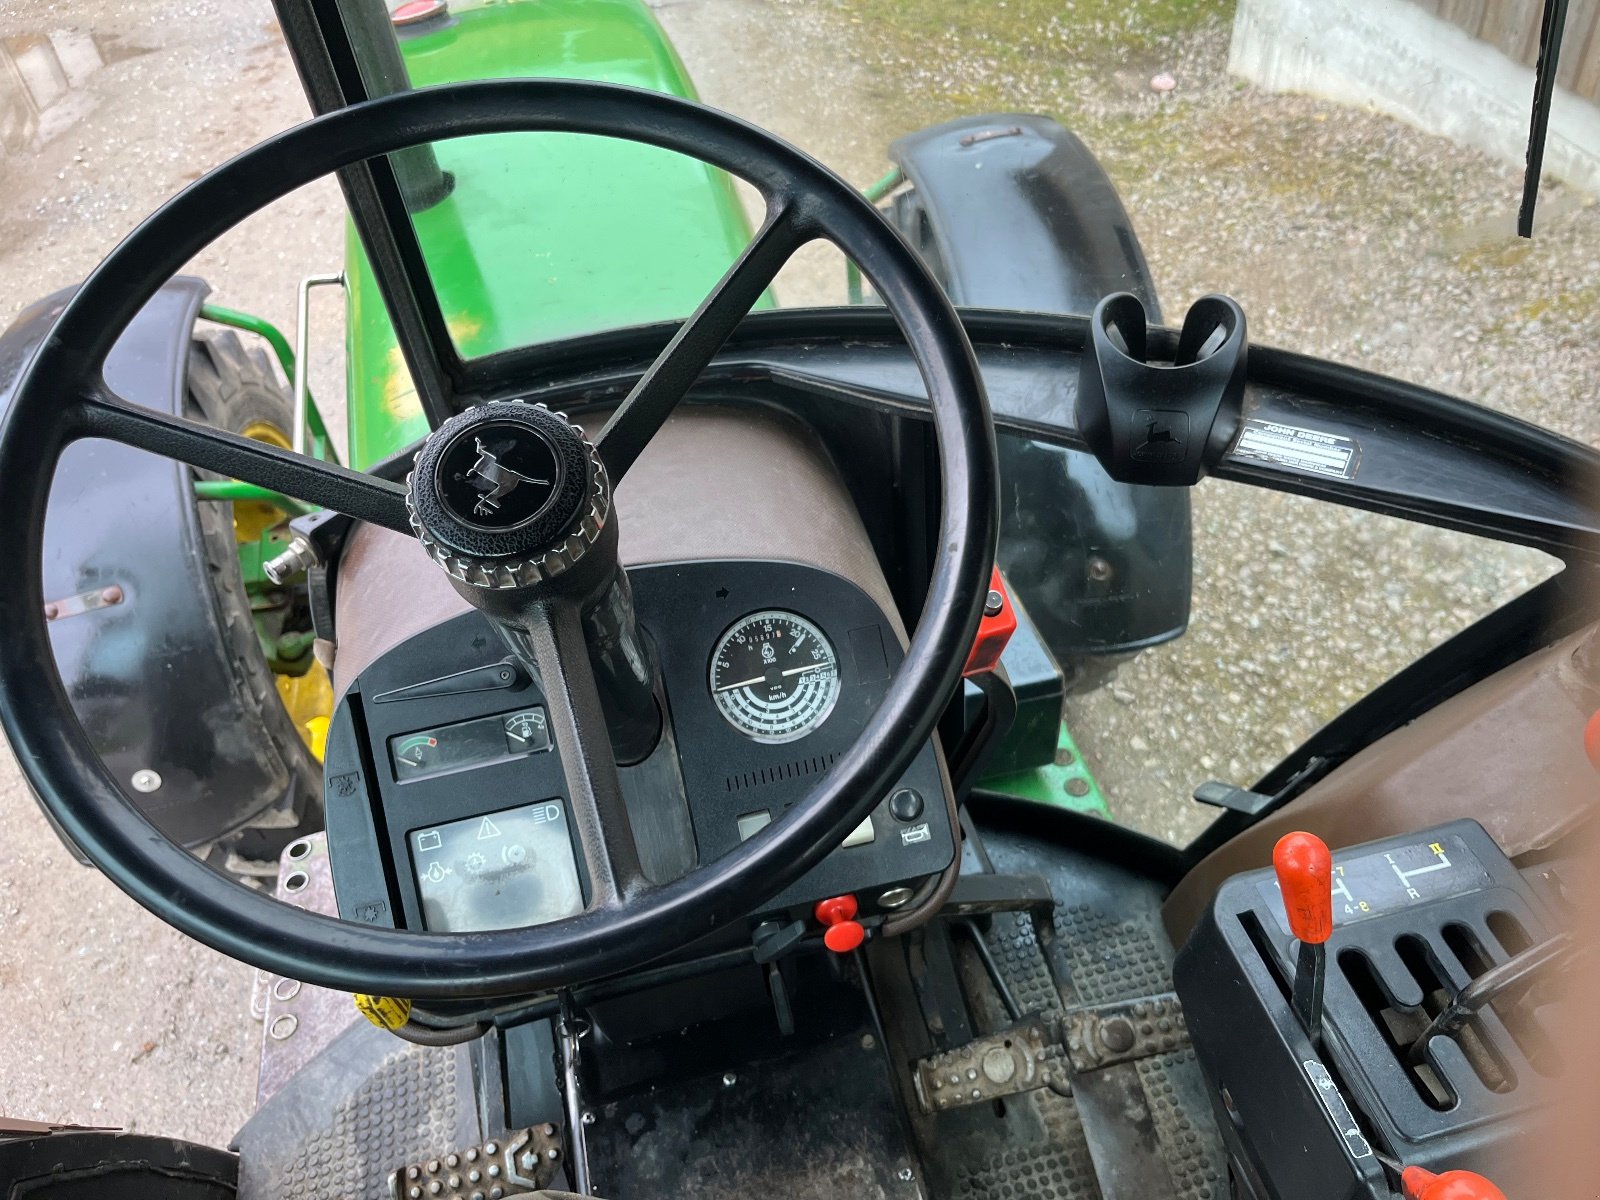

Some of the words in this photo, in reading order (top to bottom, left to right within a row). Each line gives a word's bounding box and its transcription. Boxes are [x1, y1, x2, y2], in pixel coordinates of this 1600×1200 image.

[1264, 424, 1294, 436] JOHN
[1297, 430, 1336, 444] DEERE
[763, 624, 772, 632] 15
[789, 628, 801, 638] 20
[736, 635, 746, 644] 10
[811, 648, 821, 660] 25
[768, 692, 786, 702] km/h
[1406, 888, 1421, 900] R
[1344, 901, 1370, 915] 4-8
